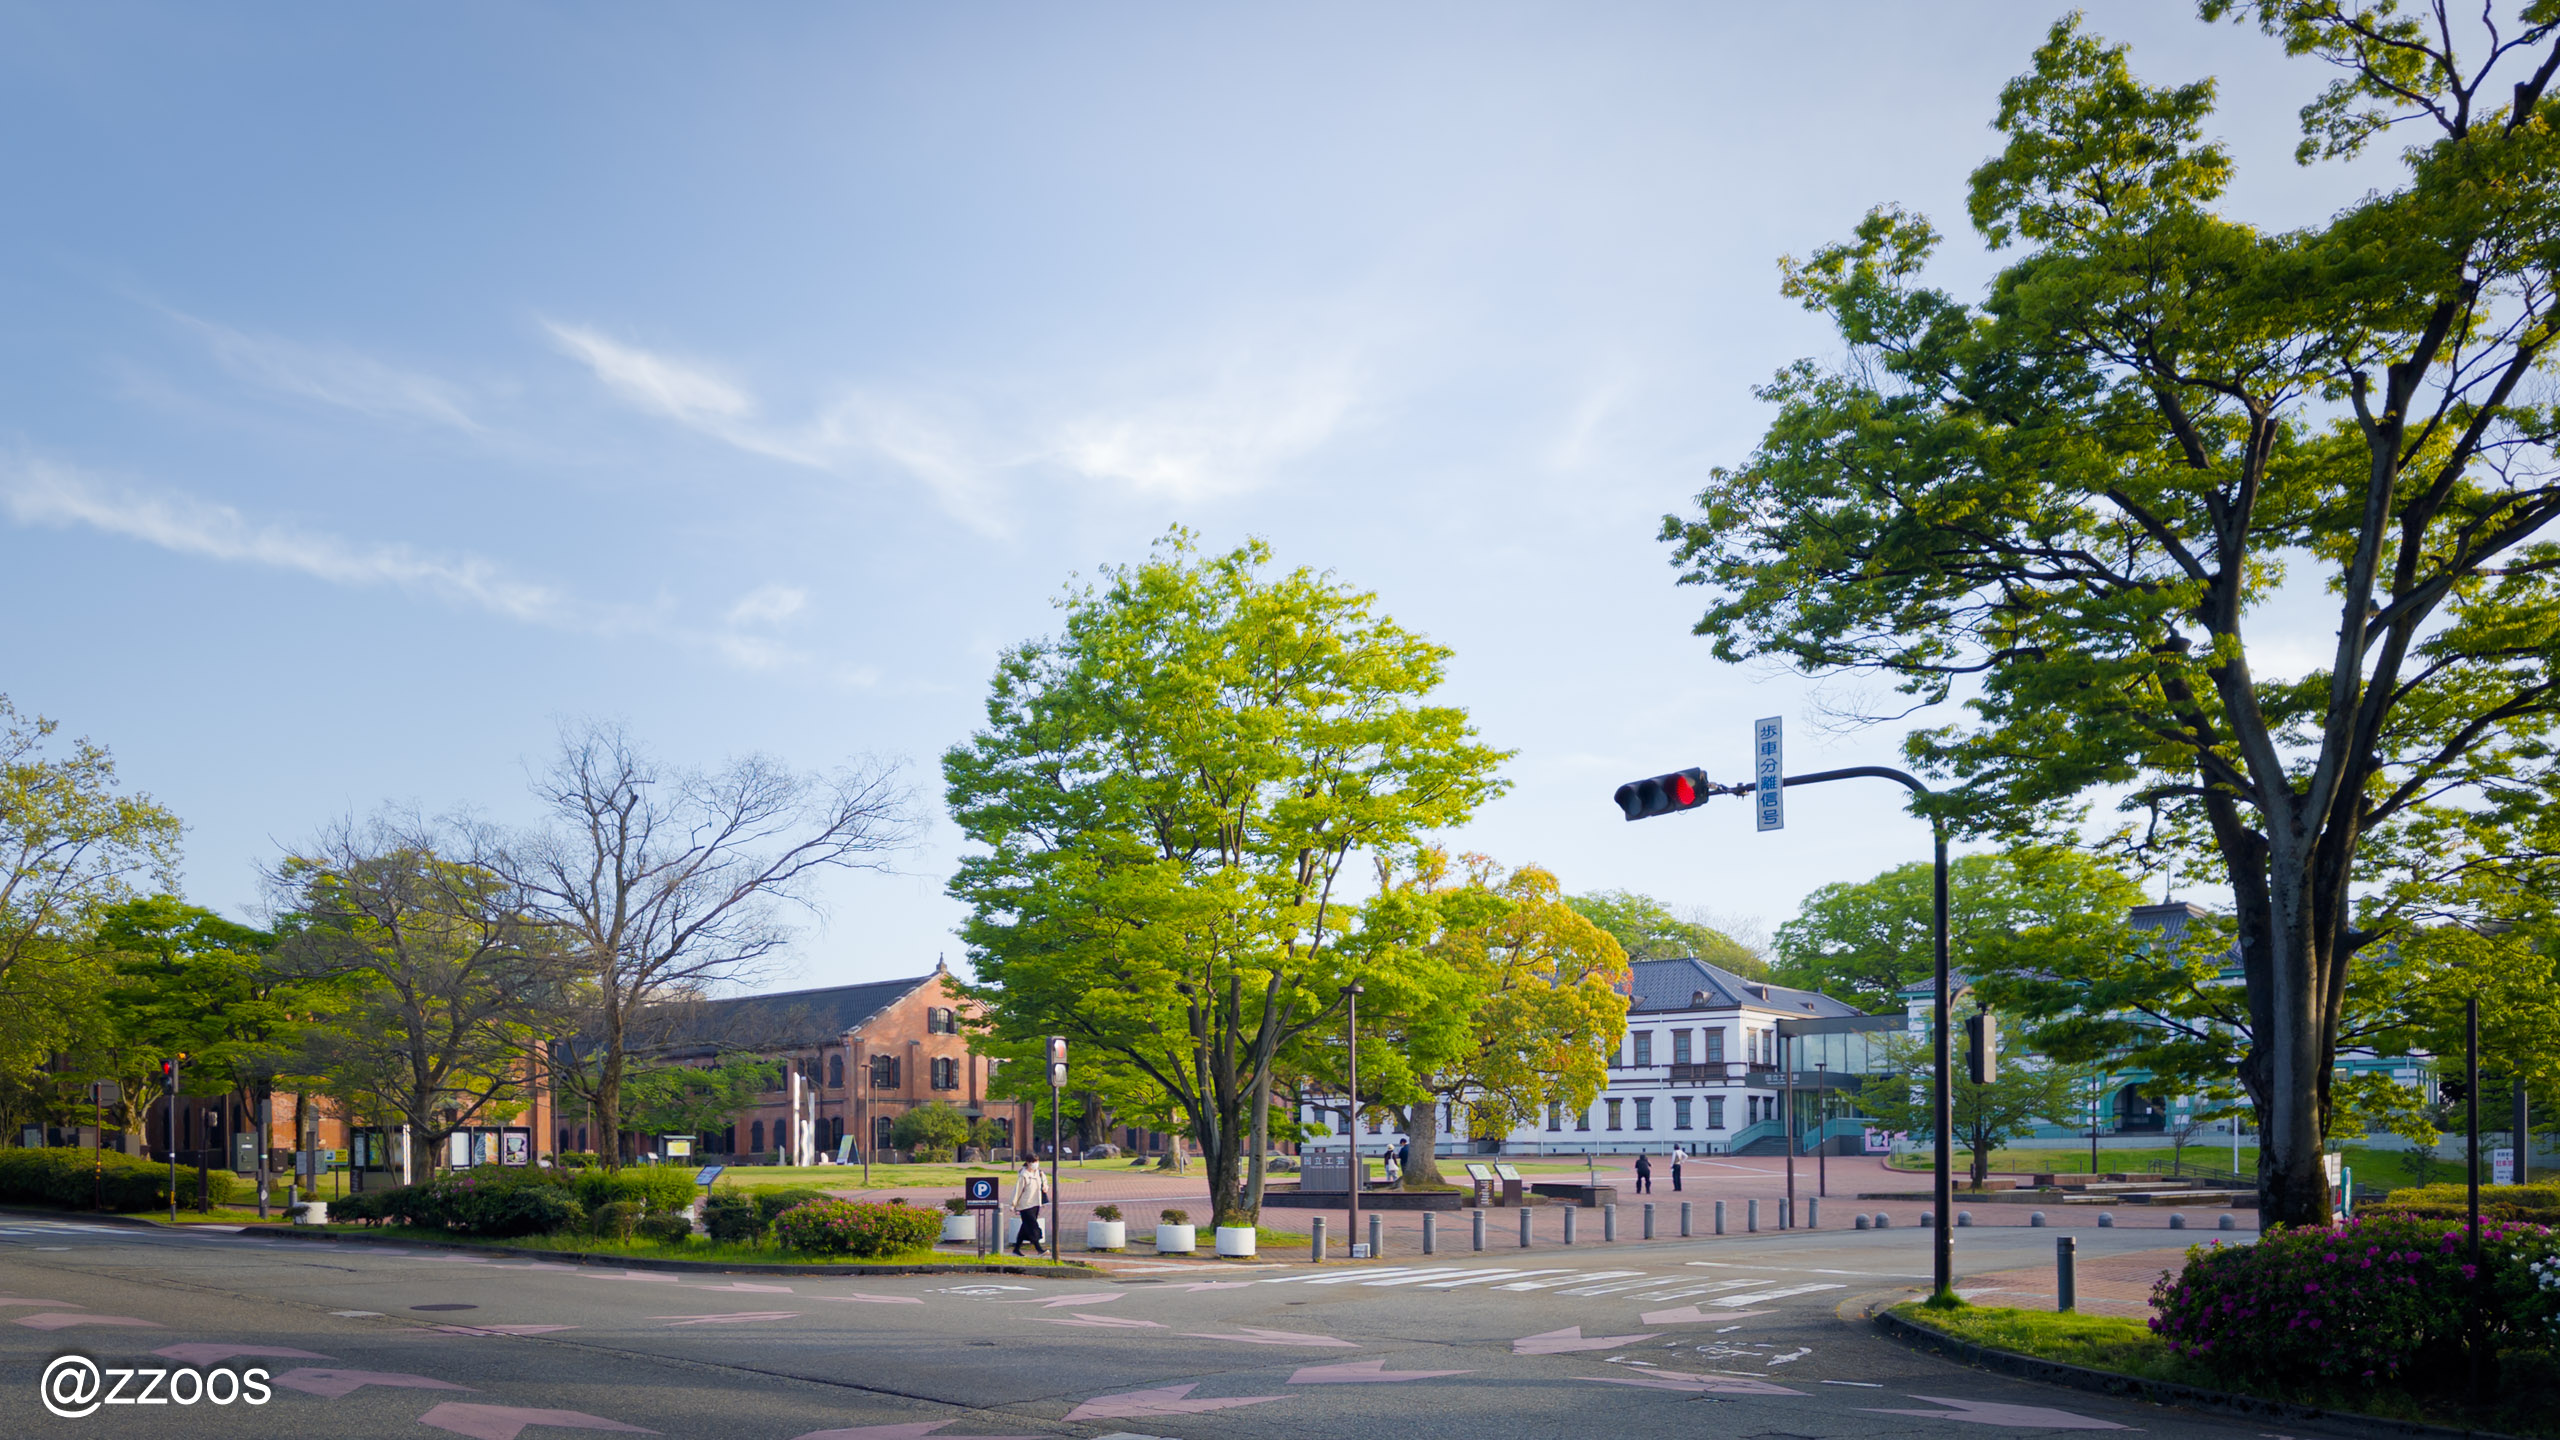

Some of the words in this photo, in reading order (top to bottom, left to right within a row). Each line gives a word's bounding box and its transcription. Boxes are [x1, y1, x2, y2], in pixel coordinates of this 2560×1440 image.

[1760, 724, 1779, 825] 歩車分離信号
[977, 1183, 988, 1196] P
